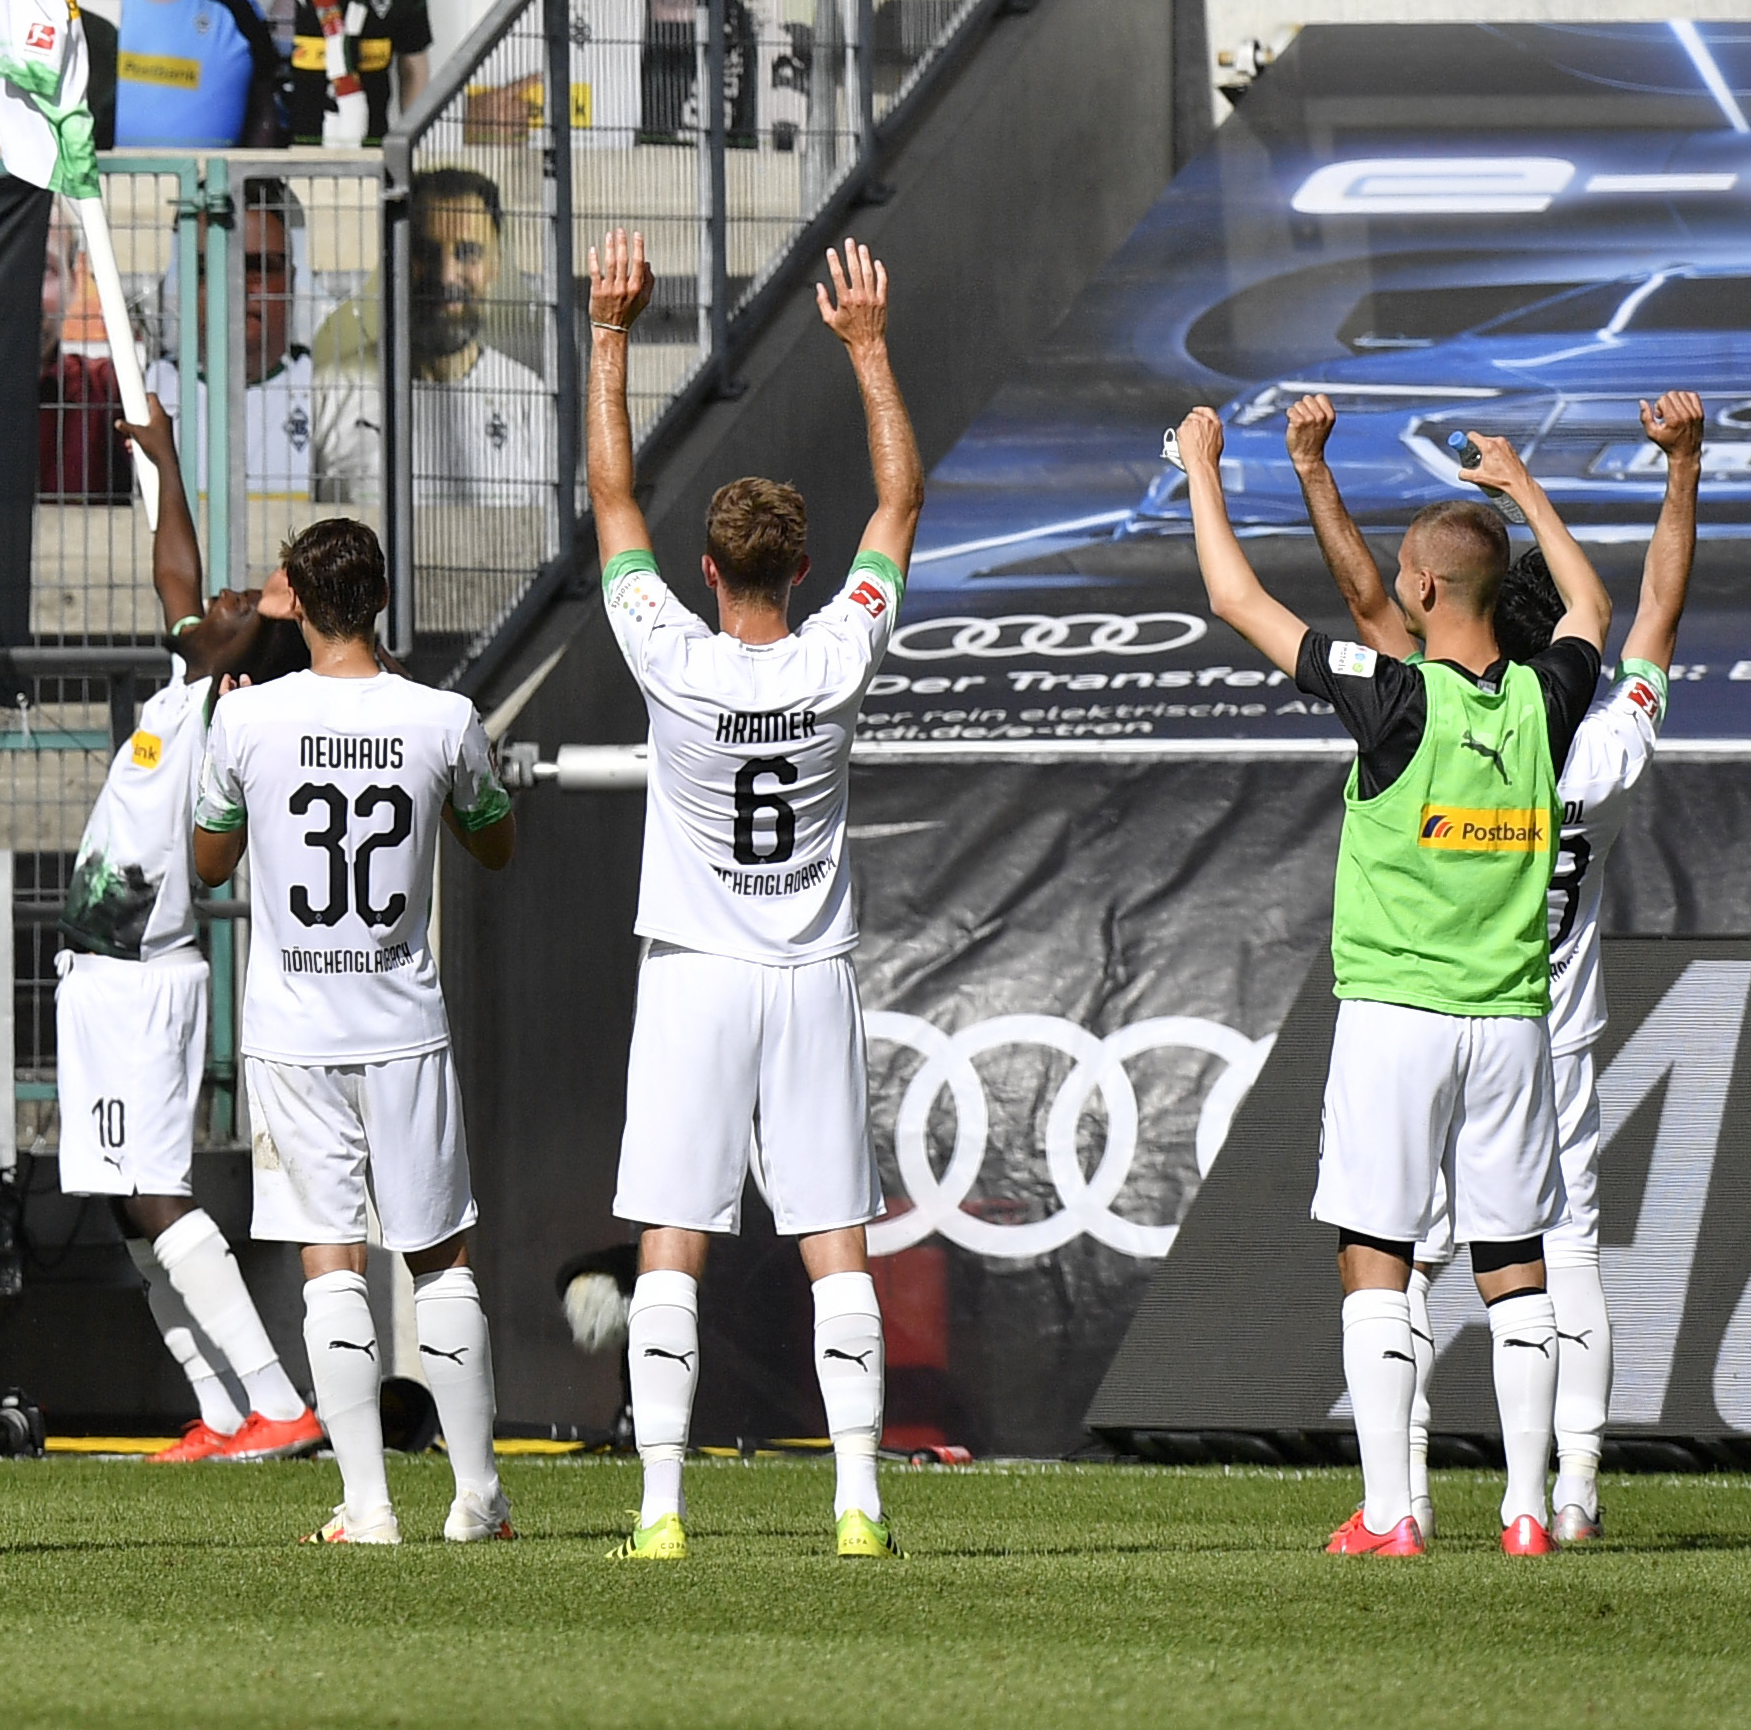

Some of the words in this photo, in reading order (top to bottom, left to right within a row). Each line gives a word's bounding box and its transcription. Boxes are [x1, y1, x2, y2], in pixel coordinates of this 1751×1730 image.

[864, 673, 987, 697] Der
[715, 711, 817, 744] KRAMER
[924, 708, 1009, 725] rein
[1018, 700, 1268, 726] elektrische
[1275, 700, 1336, 718] Au
[300, 736, 403, 770] NEUHAUS
[733, 757, 798, 866] 6
[289, 782, 414, 928] 32
[91, 1097, 125, 1149] 10
